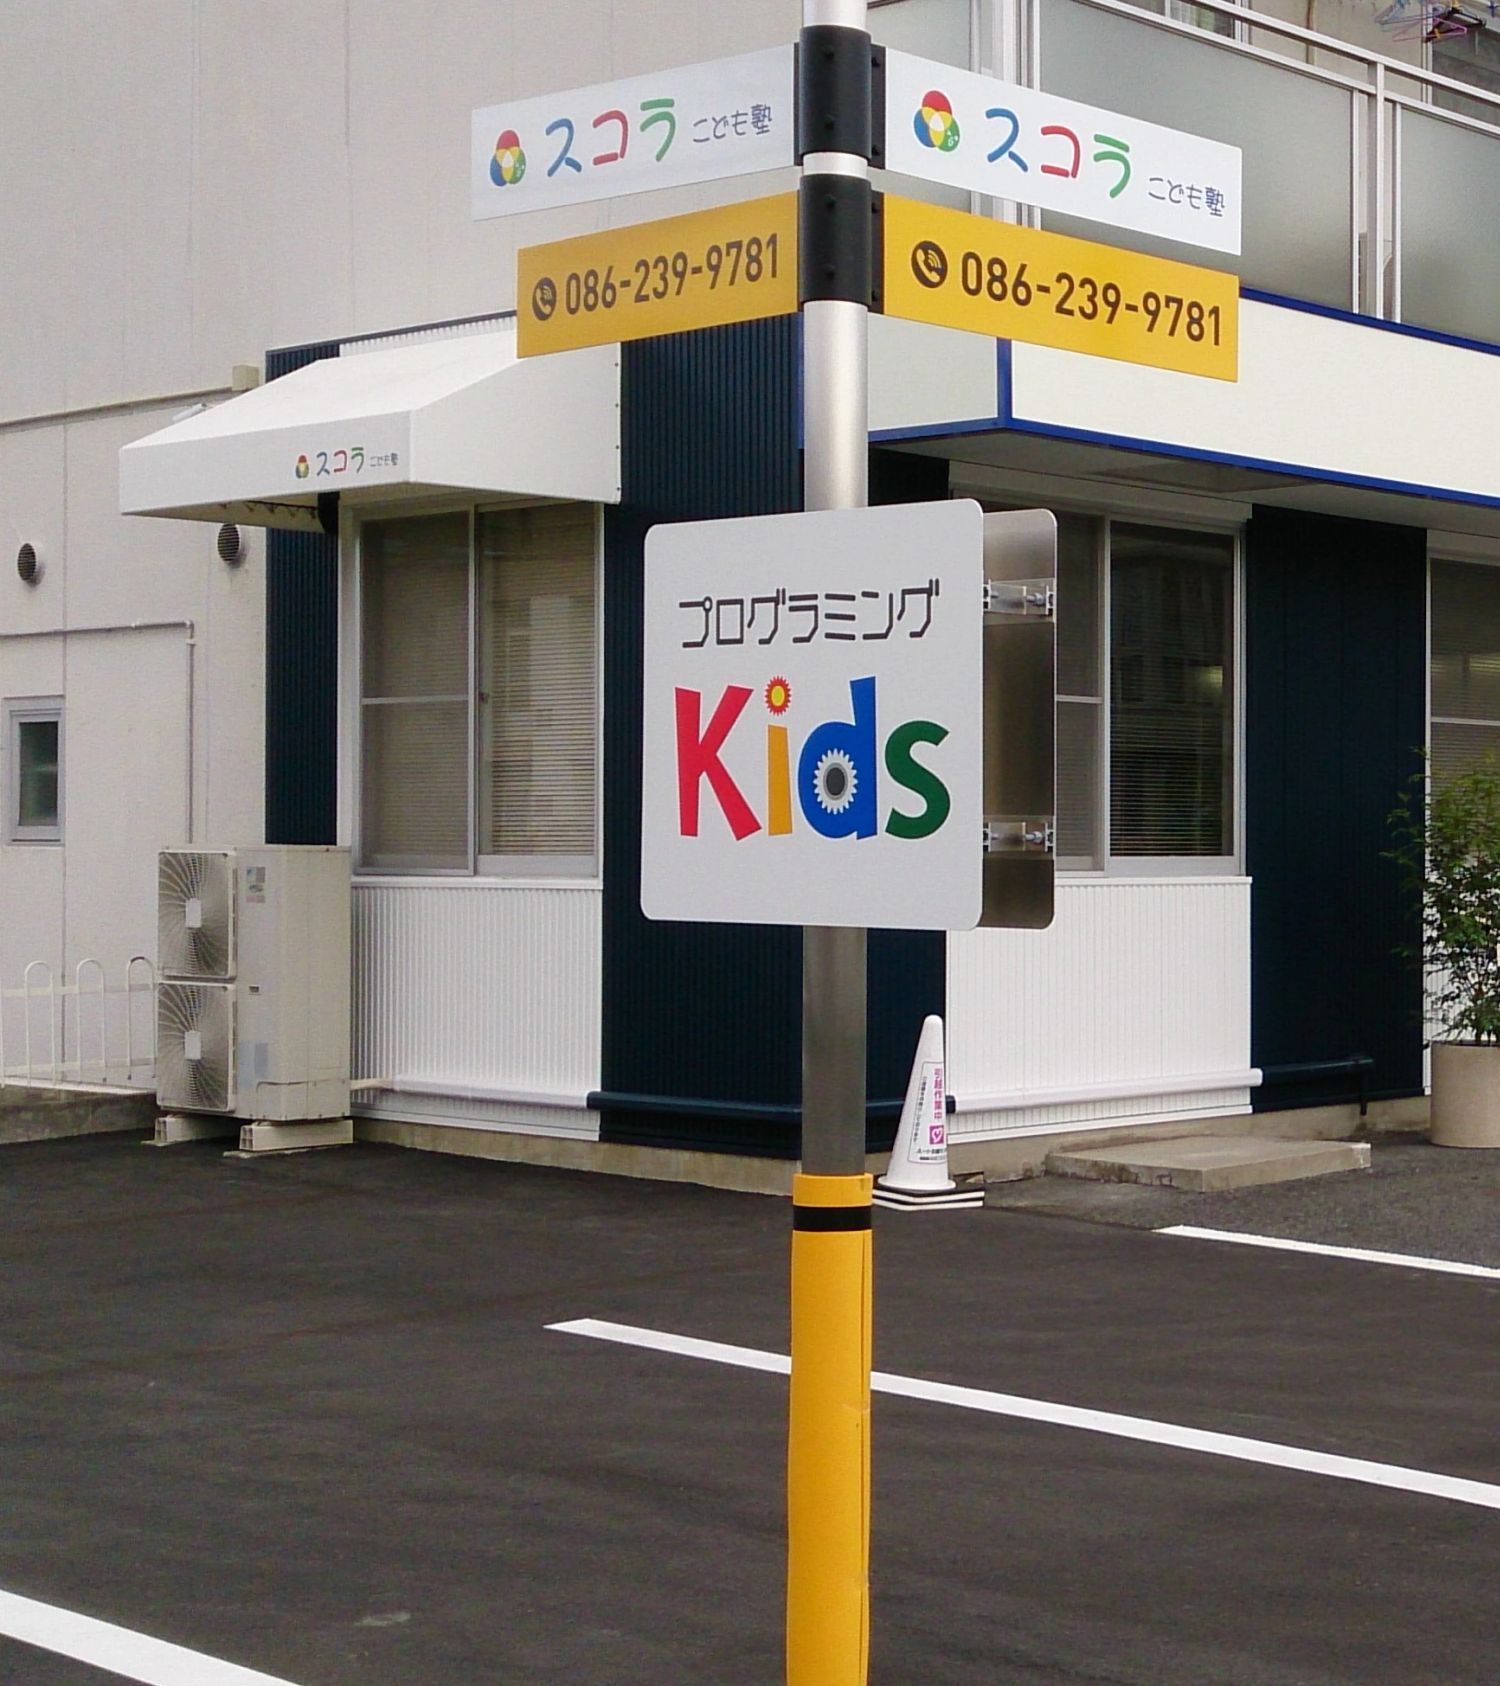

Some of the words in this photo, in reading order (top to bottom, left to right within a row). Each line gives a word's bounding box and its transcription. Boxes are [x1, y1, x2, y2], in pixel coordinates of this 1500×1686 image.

[545, 98, 676, 177] スコラ
[693, 103, 773, 143] こども塾
[984, 107, 1132, 199] スコラ
[1148, 177, 1226, 218] こども塾
[565, 233, 779, 316] 086-239-9781
[960, 251, 1221, 347] 086-239-9781
[316, 447, 365, 477] スコラ
[678, 578, 940, 648] プログラミング
[674, 675, 951, 841] Kids
